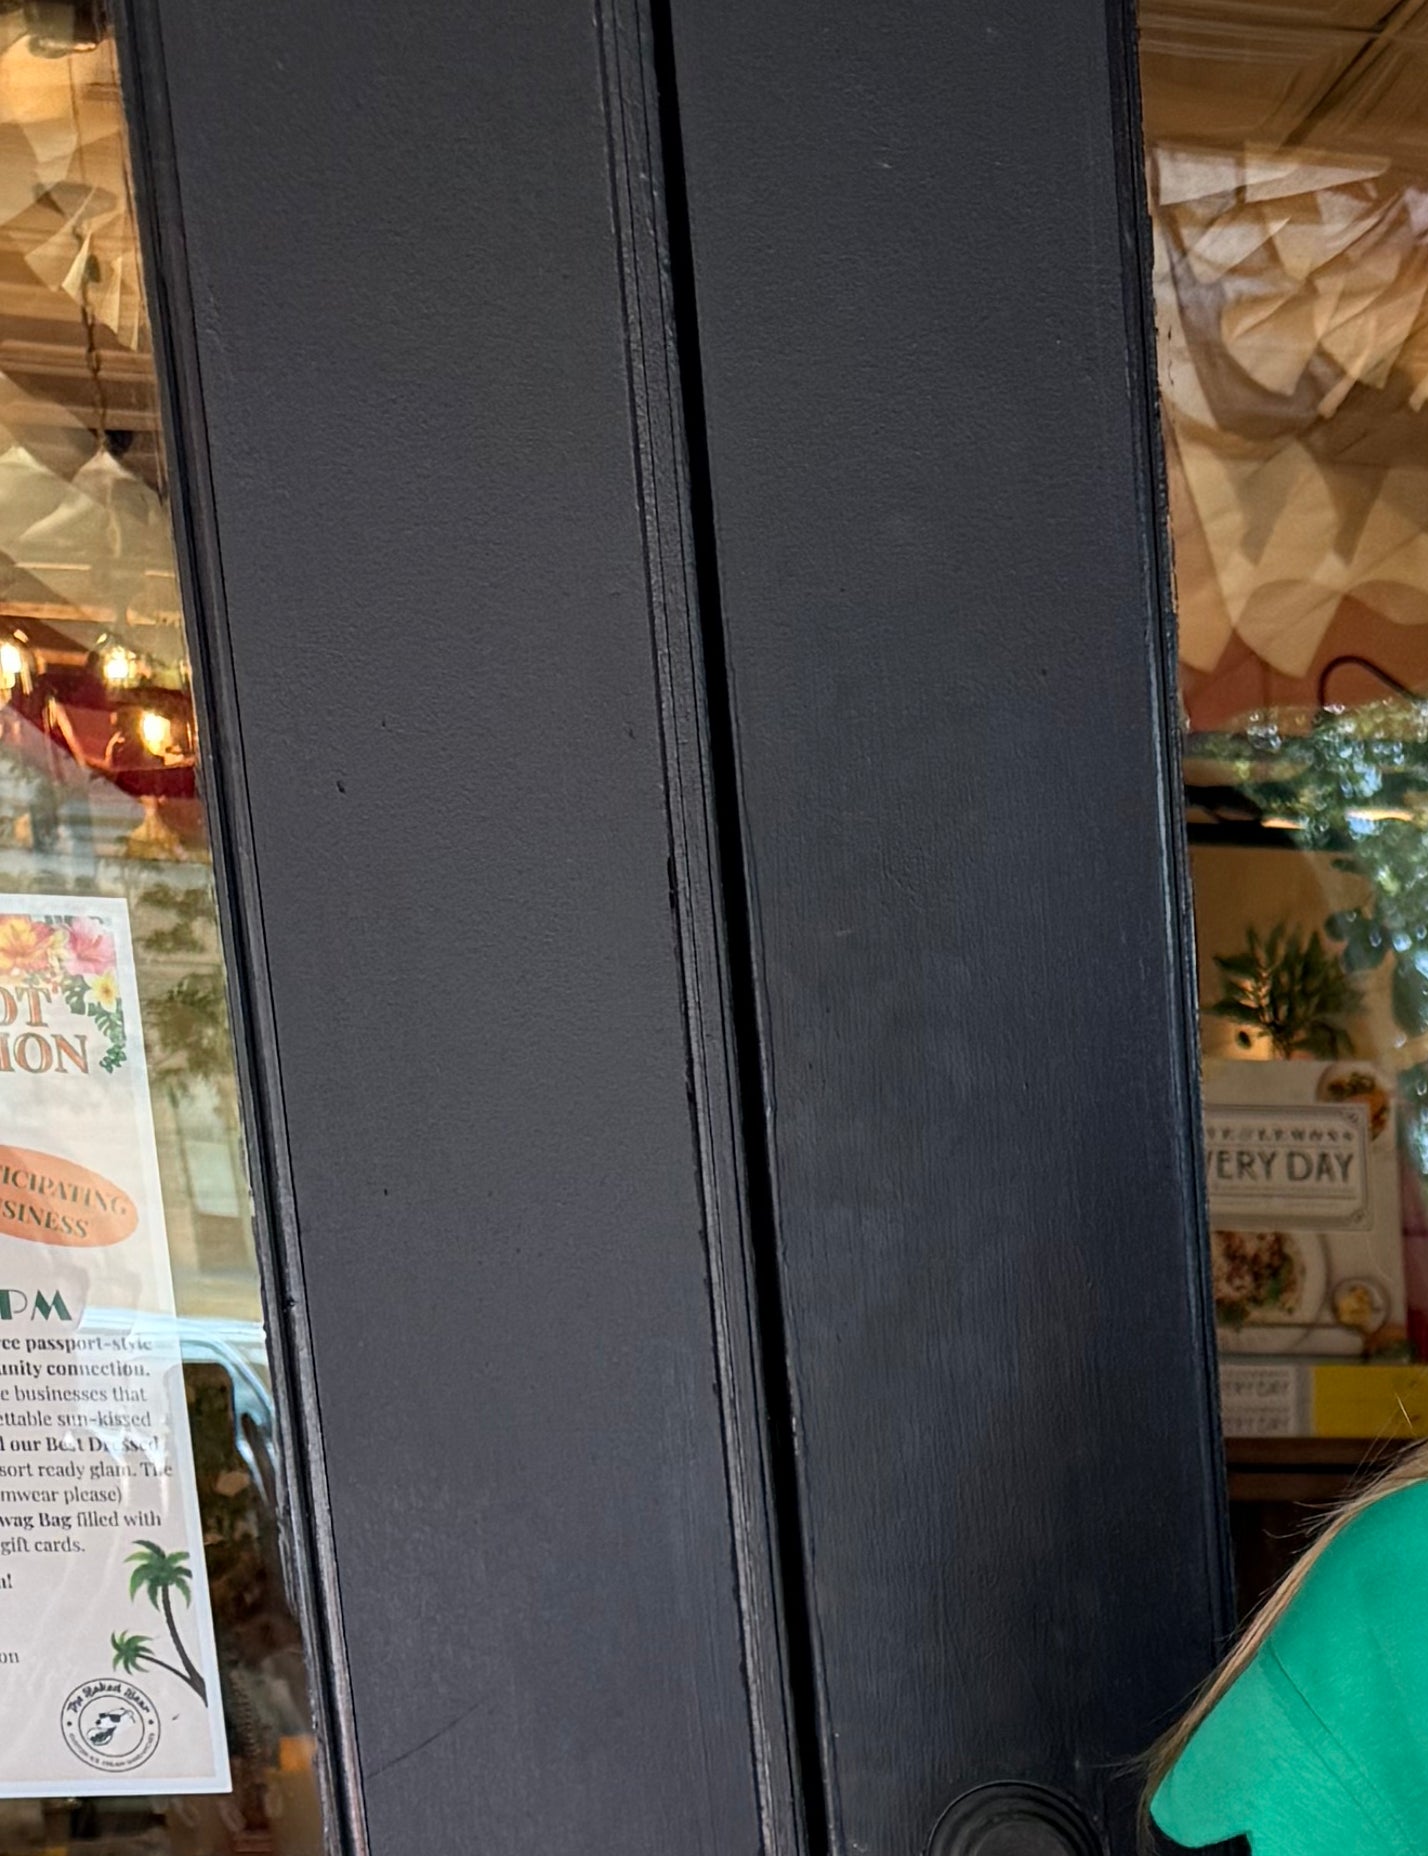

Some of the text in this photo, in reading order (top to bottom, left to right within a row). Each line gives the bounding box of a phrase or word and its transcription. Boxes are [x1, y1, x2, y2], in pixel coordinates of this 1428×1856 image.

[1286, 1151, 1354, 1183] DAY
[0, 1164, 127, 1215] ICIPATING
[0, 1289, 73, 1321] PM
[0, 1336, 152, 1353] ee passport-style
[47, 1361, 150, 1377] connection.
[14, 1385, 107, 1401] businesses
[112, 1386, 147, 1401] that
[57, 1411, 151, 1427] sun-kissed
[10, 1440, 41, 1451] our
[38, 1461, 86, 1479] ready
[90, 1461, 137, 1479] glam.
[64, 1486, 122, 1504] please)
[39, 1512, 72, 1530] Bag
[77, 1511, 119, 1527] filled
[123, 1510, 161, 1527] with
[1, 1536, 85, 1556] gift cards.
